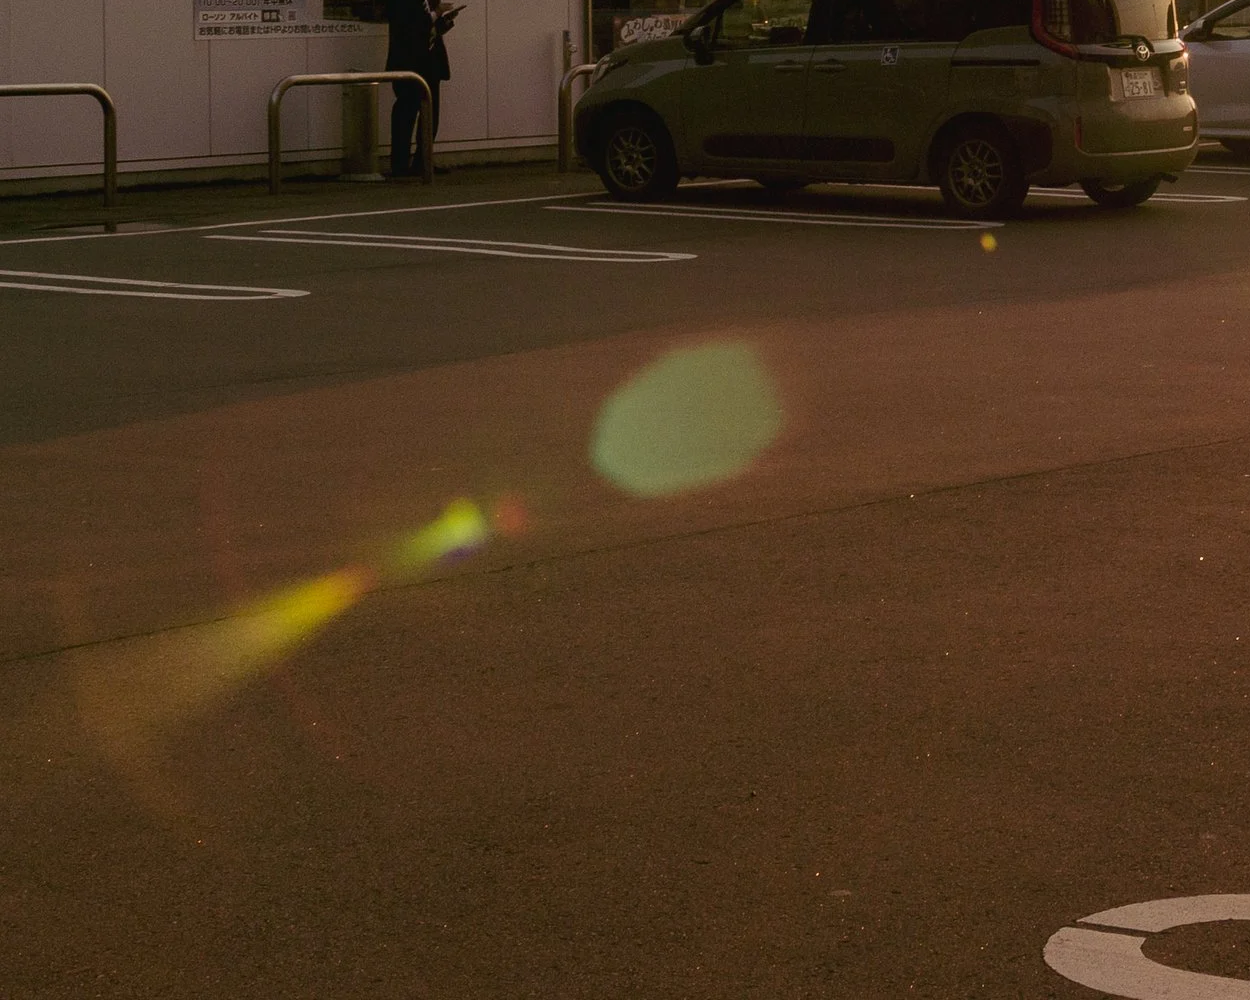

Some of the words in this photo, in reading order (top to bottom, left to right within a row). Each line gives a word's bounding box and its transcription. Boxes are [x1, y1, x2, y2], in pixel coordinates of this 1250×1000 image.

[202, 13, 226, 21] ローソン
[229, 12, 259, 21] アルバイト
